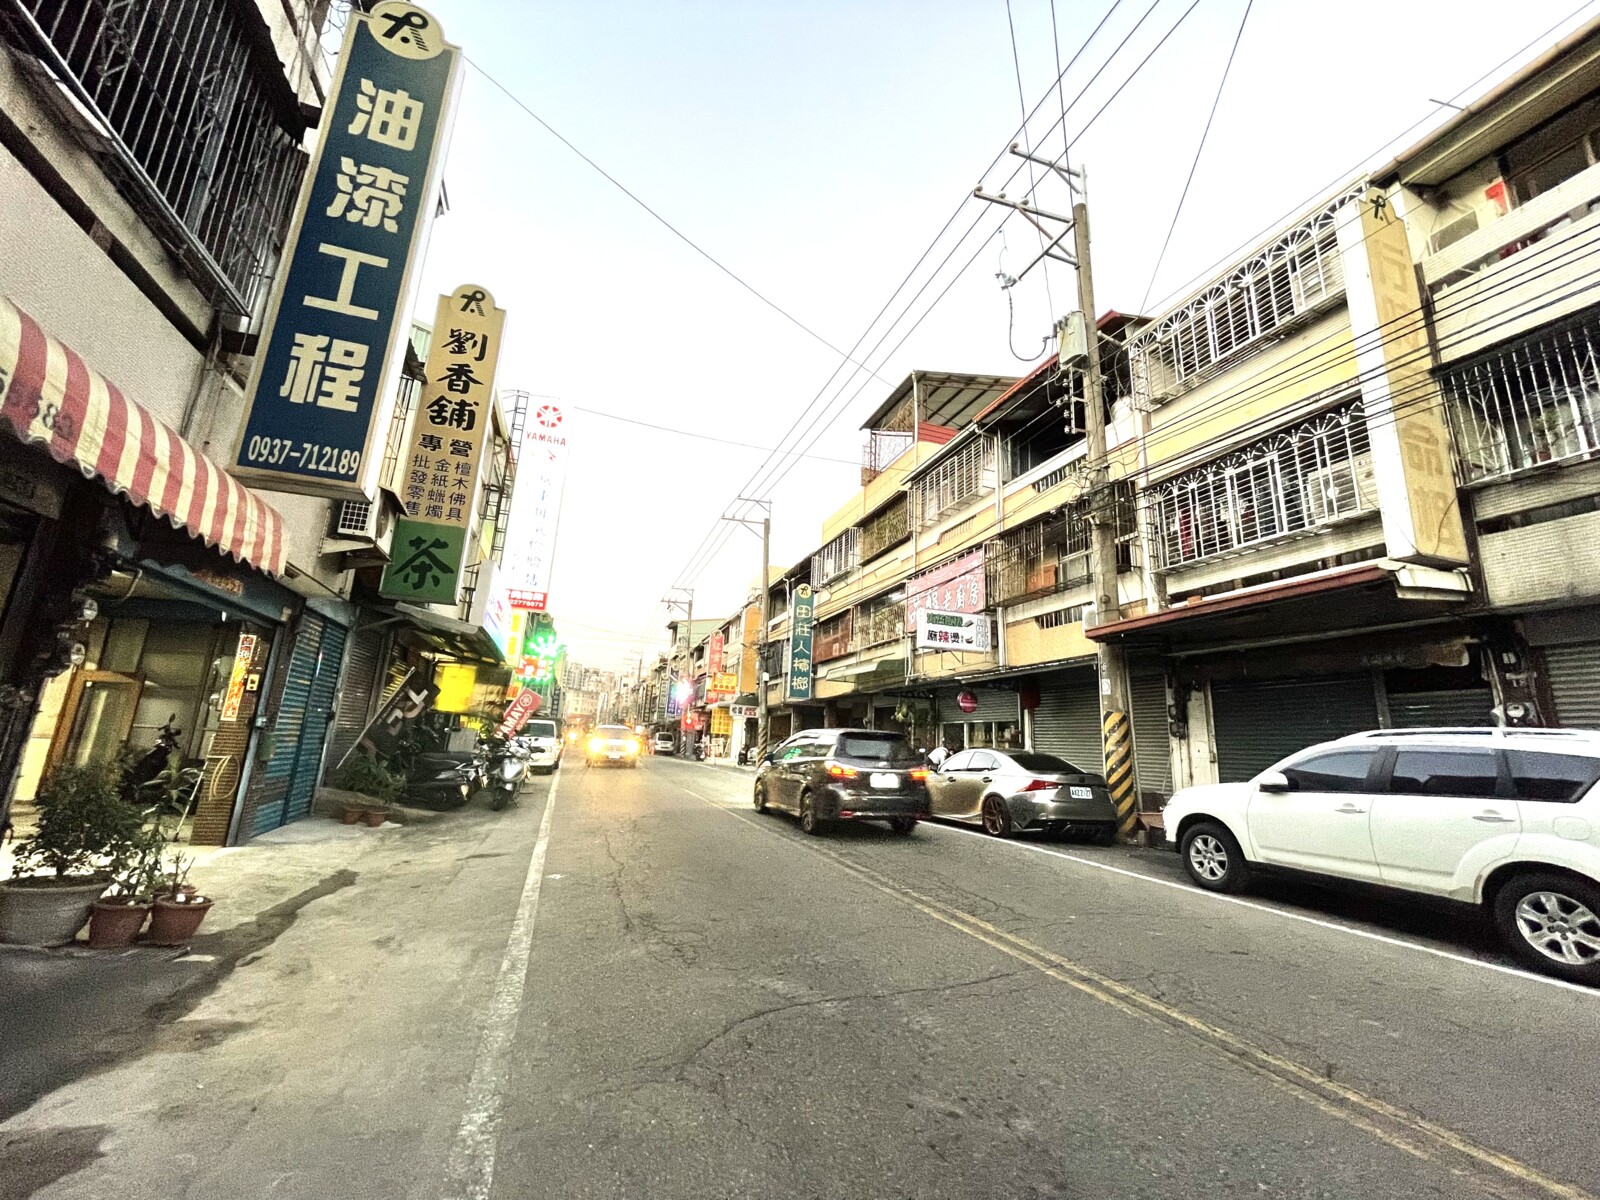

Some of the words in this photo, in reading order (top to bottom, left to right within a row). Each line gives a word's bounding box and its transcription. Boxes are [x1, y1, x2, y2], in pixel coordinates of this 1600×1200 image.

[280, 78, 425, 413] 油漆工程
[425, 327, 488, 432] 劉香舖
[247, 434, 360, 476] 0937-712189
[418, 433, 473, 458] 專營
[525, 430, 567, 447] YAMAHA
[405, 453, 431, 516] 批發零售
[425, 458, 451, 519] 金紙蠟燭
[445, 461, 472, 522] 檀木佛具
[392, 536, 454, 589] 茶
[791, 604, 812, 691] 田莊人檳榔
